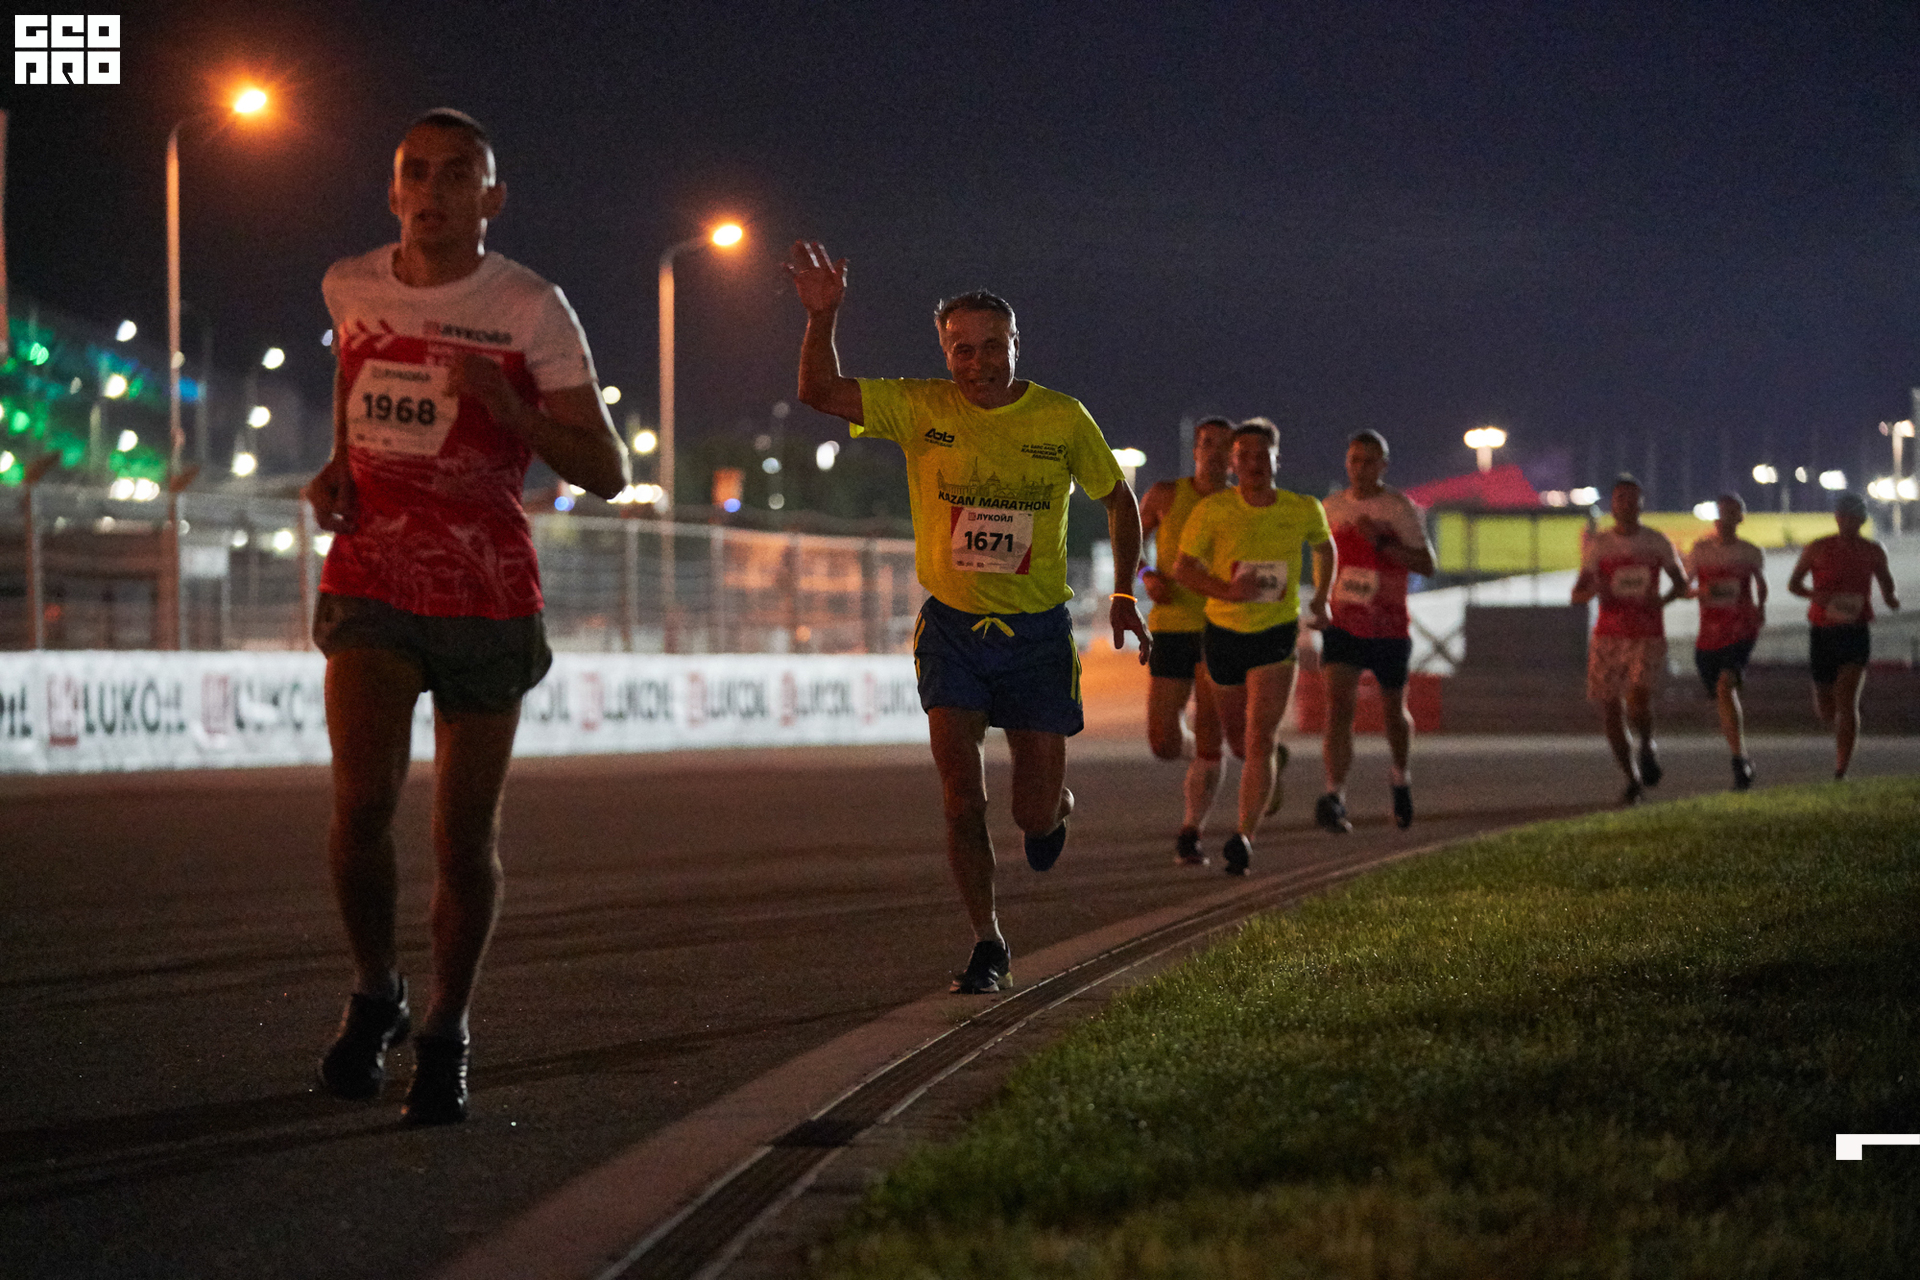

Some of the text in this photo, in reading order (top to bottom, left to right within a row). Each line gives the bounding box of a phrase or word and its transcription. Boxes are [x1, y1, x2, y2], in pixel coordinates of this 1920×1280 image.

[363, 392, 436, 426] 1968
[938, 490, 1051, 511] KAZAN MARATHON
[976, 513, 1013, 523] ЛУКОЙЛ
[964, 530, 1014, 552] 1671
